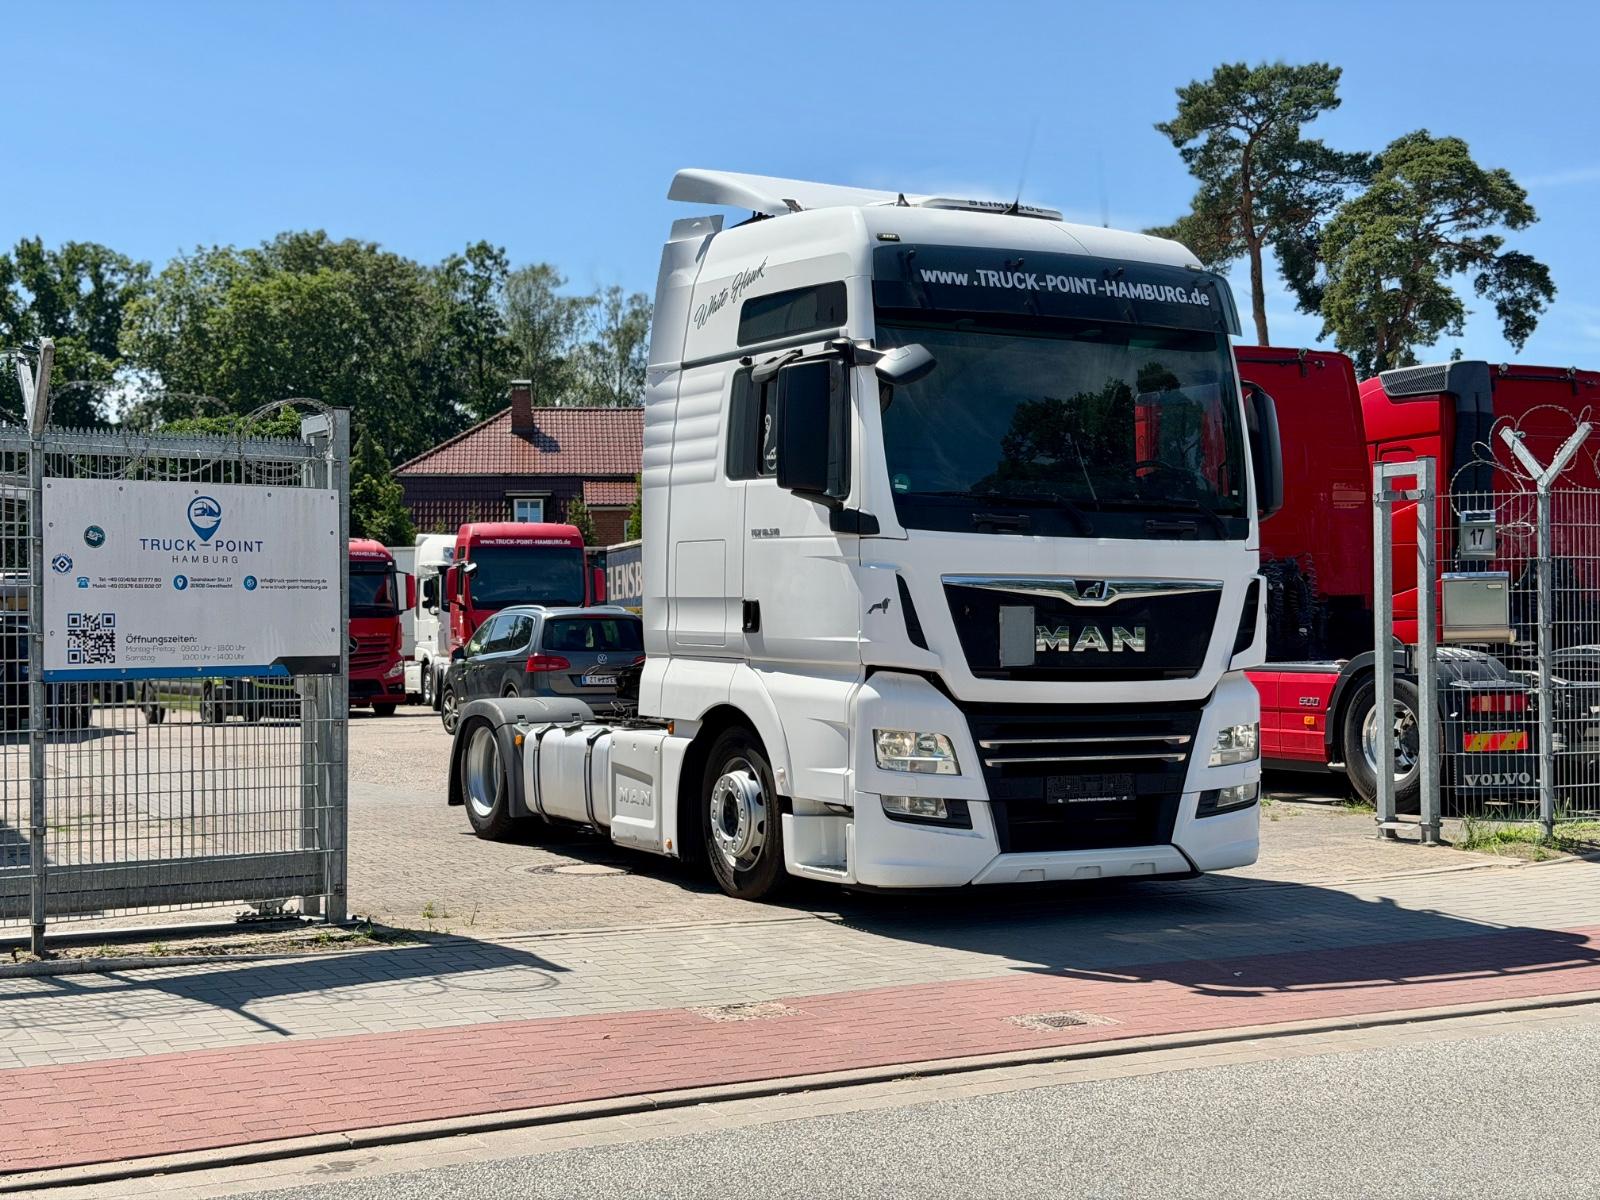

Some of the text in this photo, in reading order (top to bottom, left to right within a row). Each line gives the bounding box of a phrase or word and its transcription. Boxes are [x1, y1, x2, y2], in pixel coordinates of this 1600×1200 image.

[1470, 528, 1485, 545] 17
[172, 555, 238, 564] HAMBURG
[125, 633, 198, 646] Öffnungszeiten:
[1036, 626, 1146, 652] MAN
[1464, 772, 1531, 786] VOLVO
[619, 786, 651, 807] MAN
